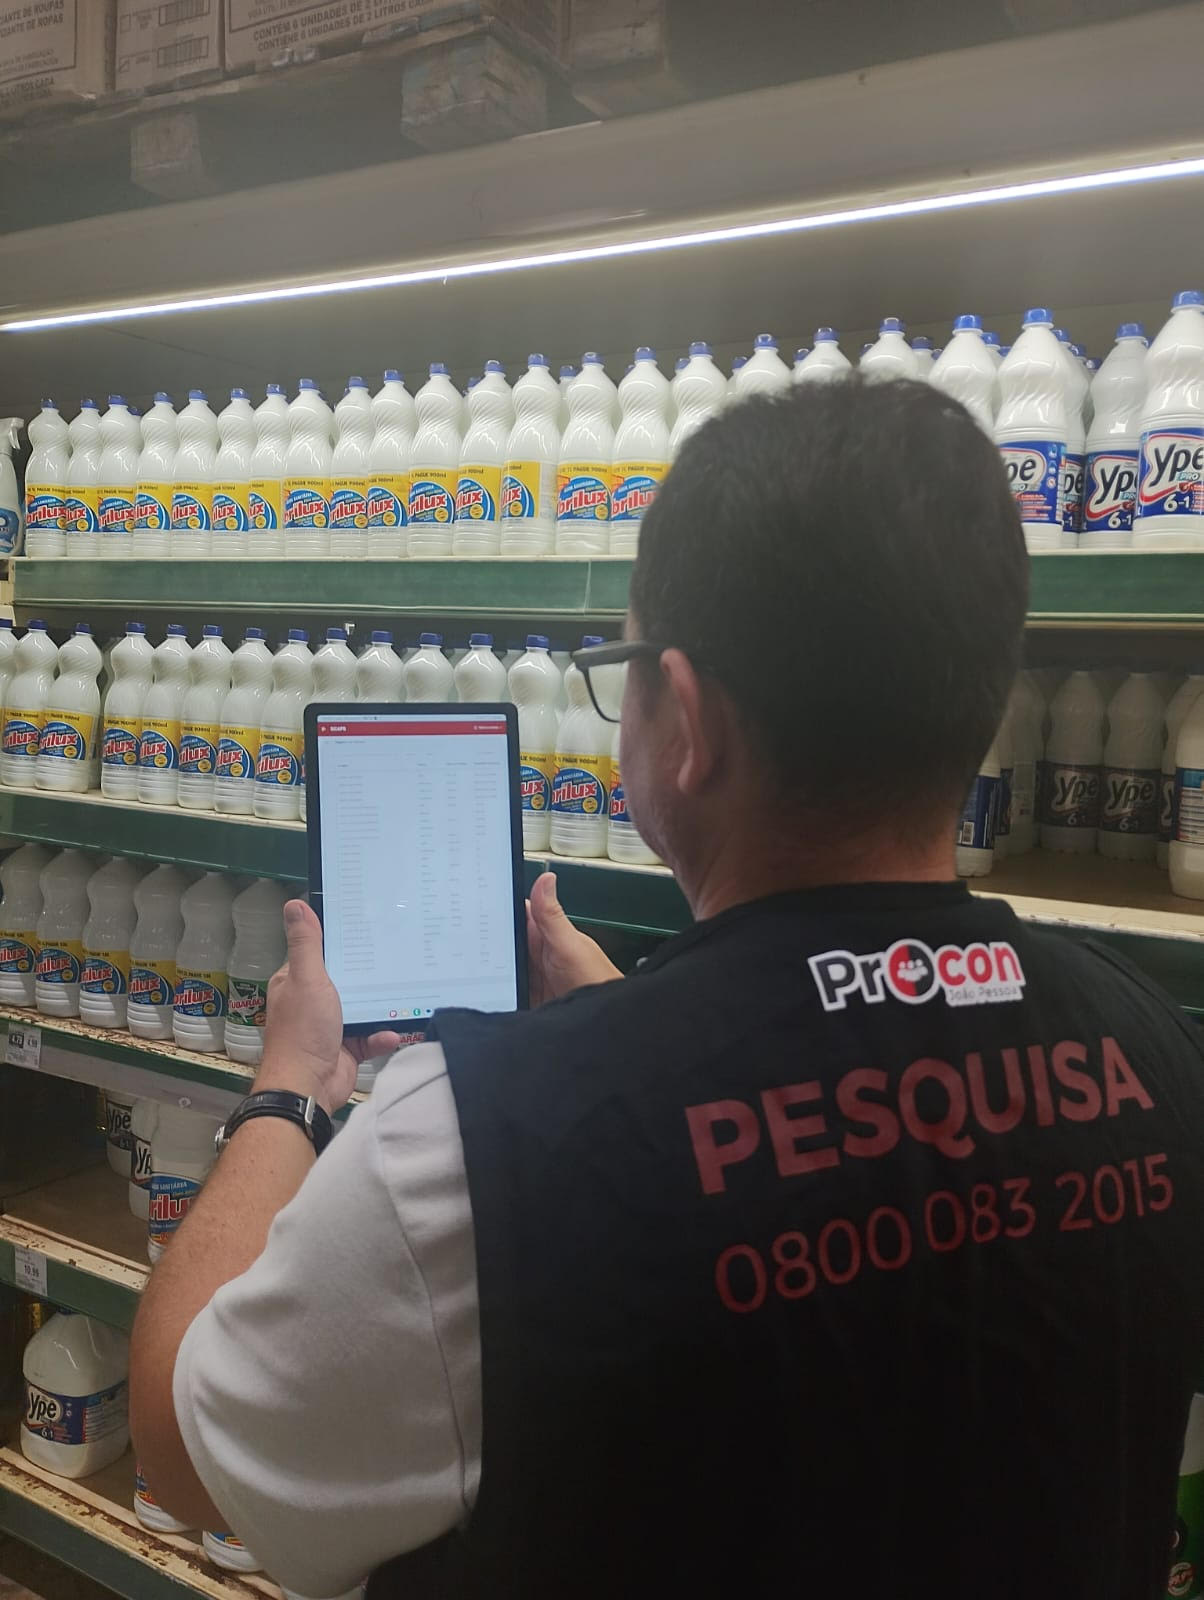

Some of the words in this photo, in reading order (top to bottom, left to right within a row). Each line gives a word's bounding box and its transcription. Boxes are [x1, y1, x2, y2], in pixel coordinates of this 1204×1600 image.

[300, 6, 347, 28] UNIDADES
[350, 0, 362, 16] DE
[308, 18, 352, 38] UNIDADES
[353, 12, 365, 25] DE
[374, 1, 406, 18] LITROS
[173, 504, 199, 521] ilux
[330, 501, 366, 523] rilux
[557, 489, 607, 517] brilux
[611, 489, 657, 517] brilu
[140, 740, 167, 760] ilux
[684, 1036, 1155, 1195] PESQUISA
[149, 1193, 189, 1221] rilu
[715, 1205, 912, 1314] 0800
[923, 1177, 1036, 1254] 083
[1055, 1153, 1174, 1232] 2015
